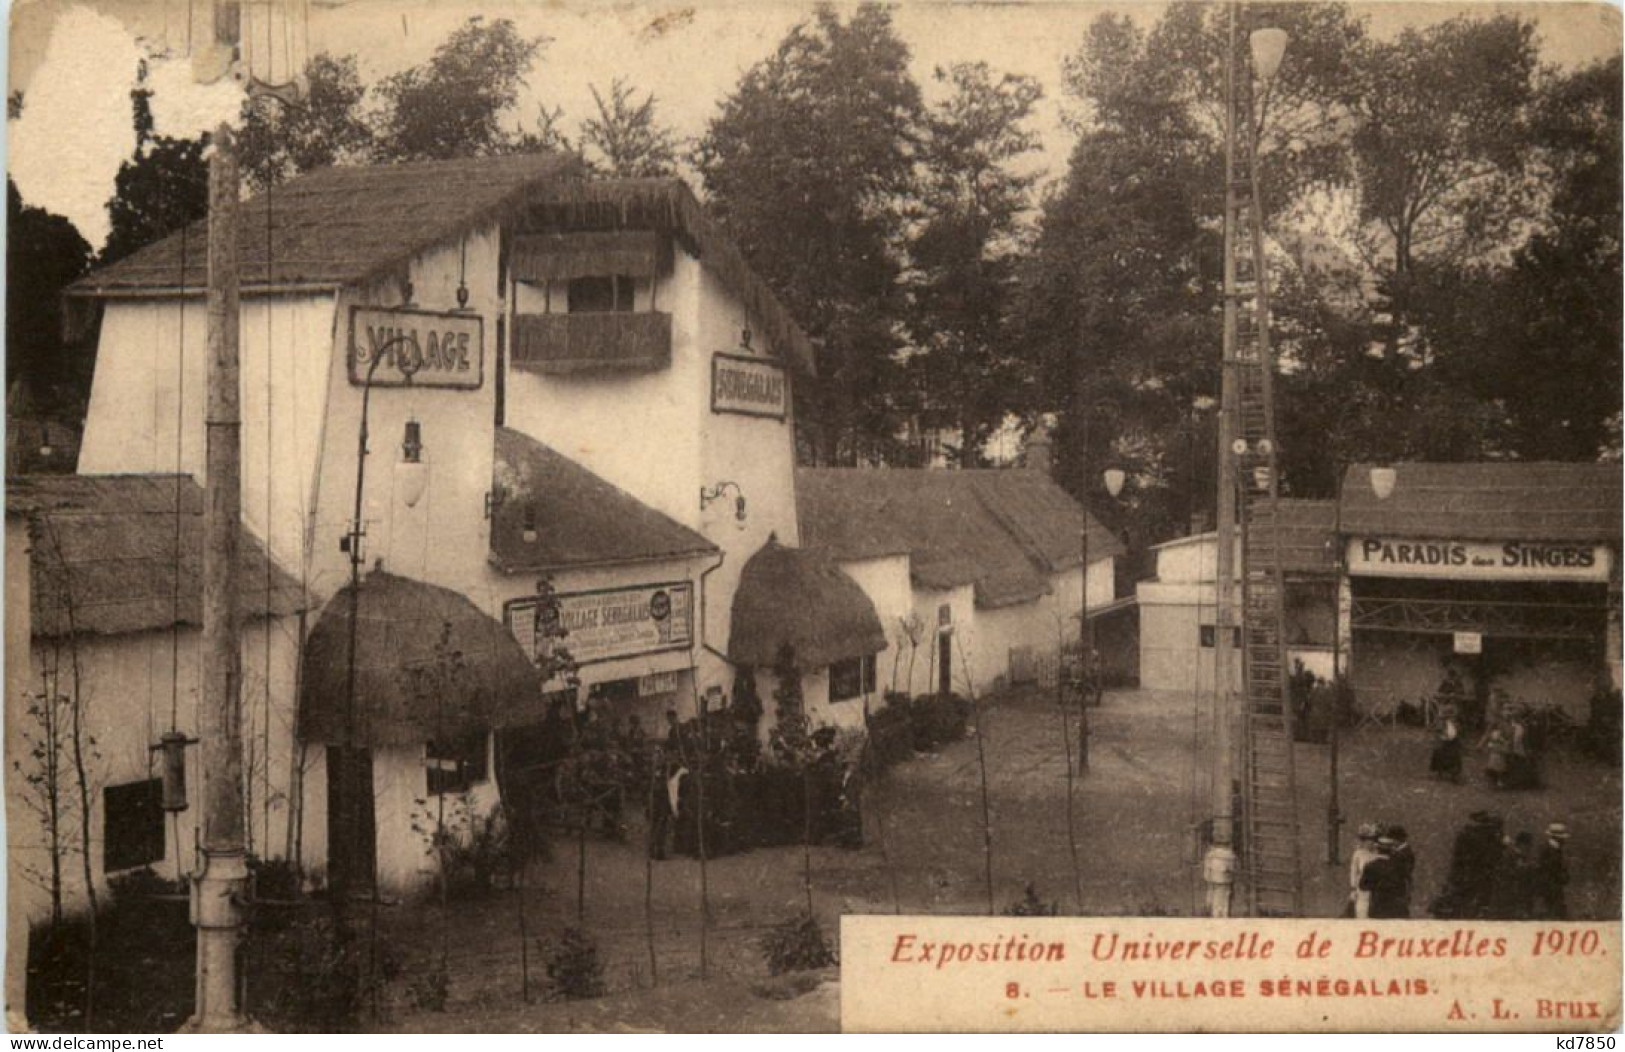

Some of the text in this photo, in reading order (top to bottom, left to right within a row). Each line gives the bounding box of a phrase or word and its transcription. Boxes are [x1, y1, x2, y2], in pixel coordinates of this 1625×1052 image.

[366, 326, 470, 371] VILLAGE
[1362, 538, 1467, 566] PARADIS
[1502, 540, 1595, 568] SINGES
[560, 608, 598, 631] VILLAGE
